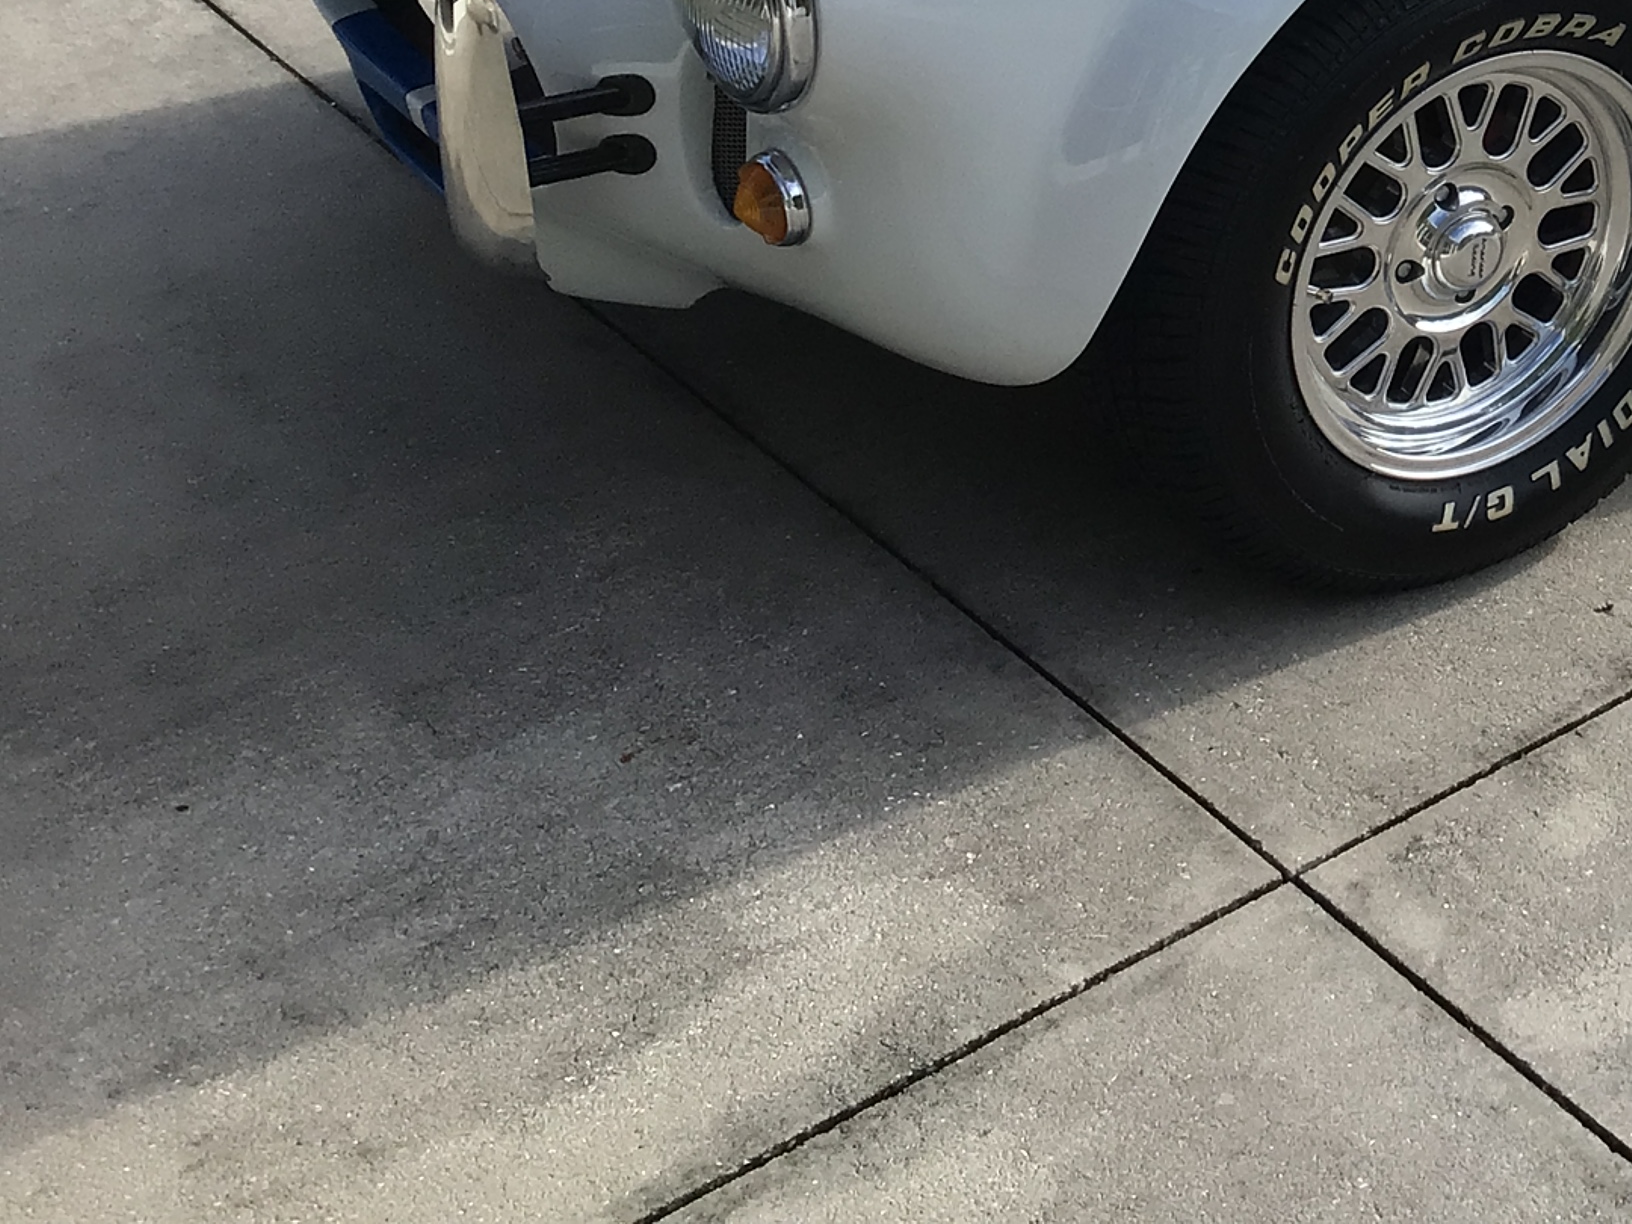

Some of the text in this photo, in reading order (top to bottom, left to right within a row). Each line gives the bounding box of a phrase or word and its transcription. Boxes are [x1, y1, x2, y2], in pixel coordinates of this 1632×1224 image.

[1275, 12, 1627, 286] COOPER COBRA
[1432, 485, 1515, 533] G/T
